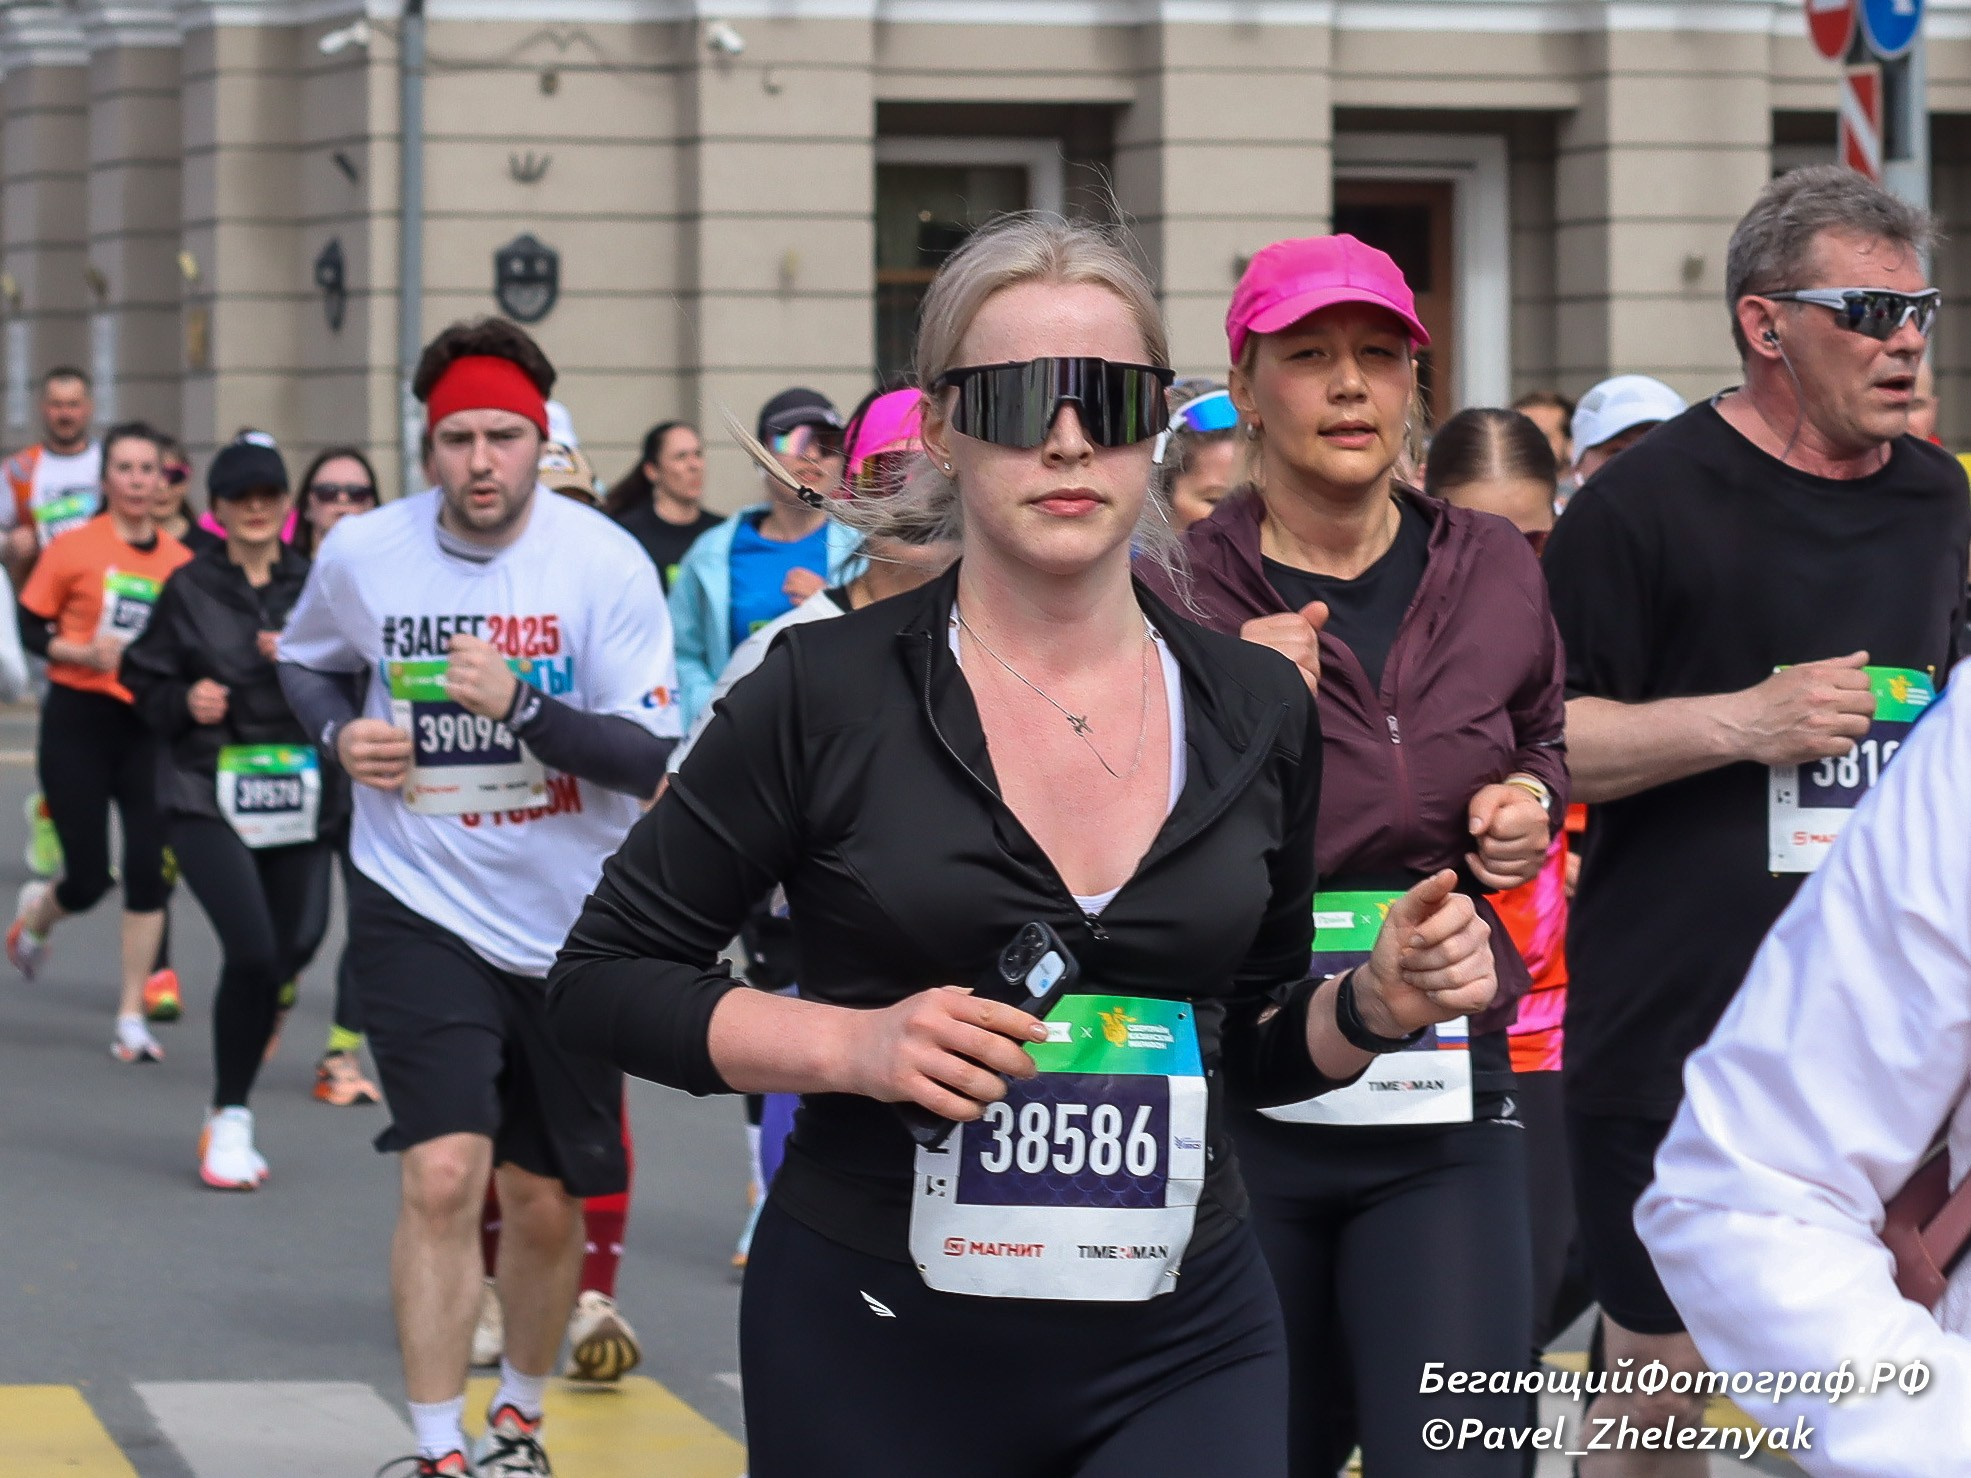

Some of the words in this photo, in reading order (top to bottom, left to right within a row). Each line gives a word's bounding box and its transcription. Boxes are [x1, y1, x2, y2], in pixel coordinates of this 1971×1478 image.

[419, 713, 515, 754] 39094
[979, 1100, 1158, 1177] 38586
[969, 1241, 1046, 1258] МАГНИТ
